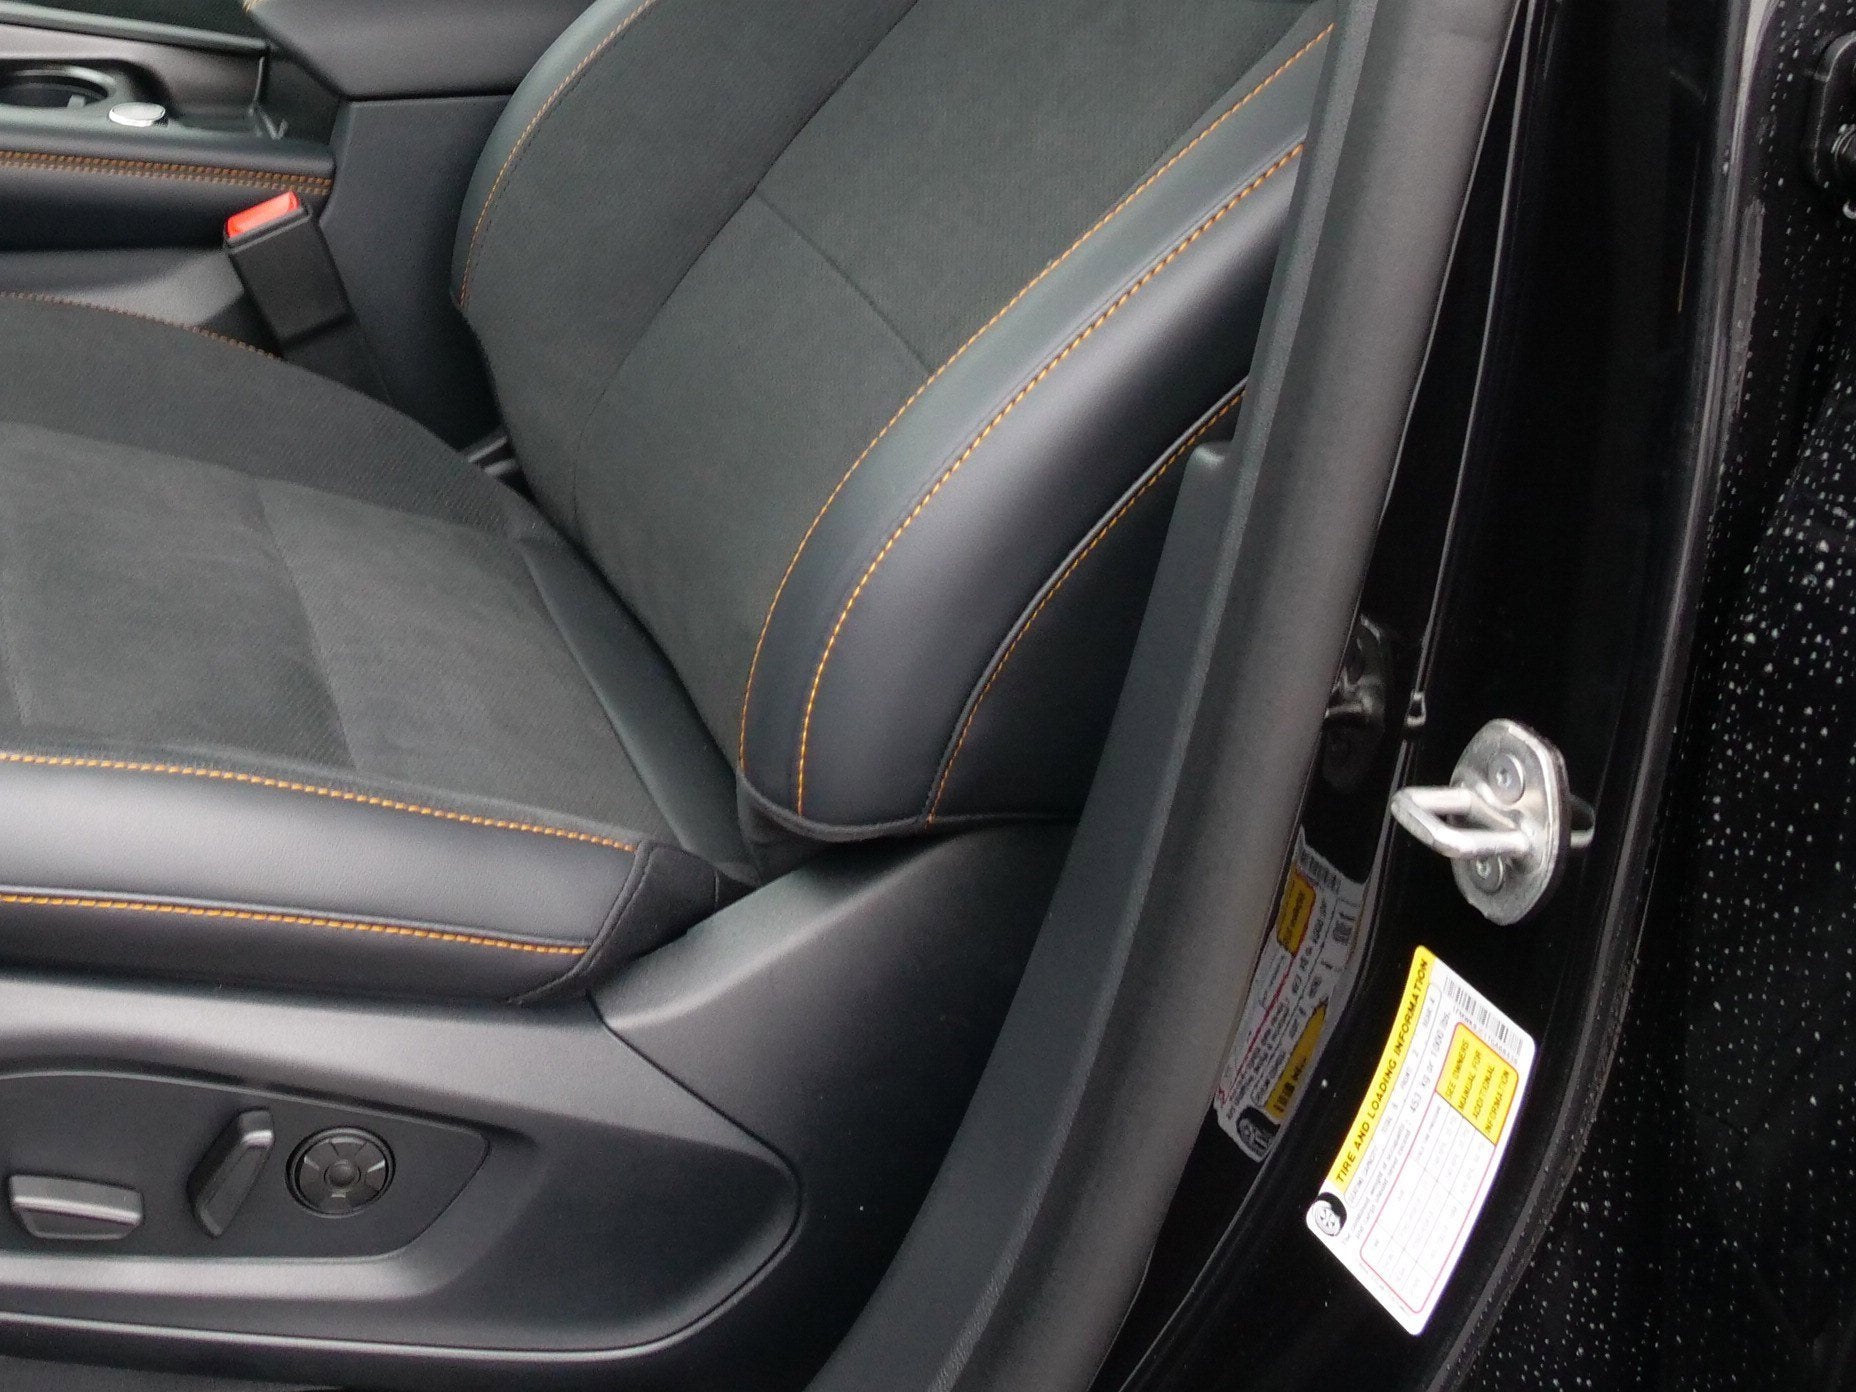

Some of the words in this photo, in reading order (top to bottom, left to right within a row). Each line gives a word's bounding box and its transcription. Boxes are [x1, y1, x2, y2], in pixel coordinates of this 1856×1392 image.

[1335, 1150, 1356, 1186] TIRE
[1353, 1119, 1370, 1152] AND
[1367, 1057, 1397, 1120] LOADING
[1393, 957, 1429, 1056] INFORMATION
[1444, 1079, 1455, 1099] SEE
[1456, 1069, 1476, 1111] MANUAL
[1472, 1049, 1482, 1070] FOR
[1470, 1063, 1495, 1120] ADDITIONAL
[1483, 1068, 1510, 1134] INFORMATION
